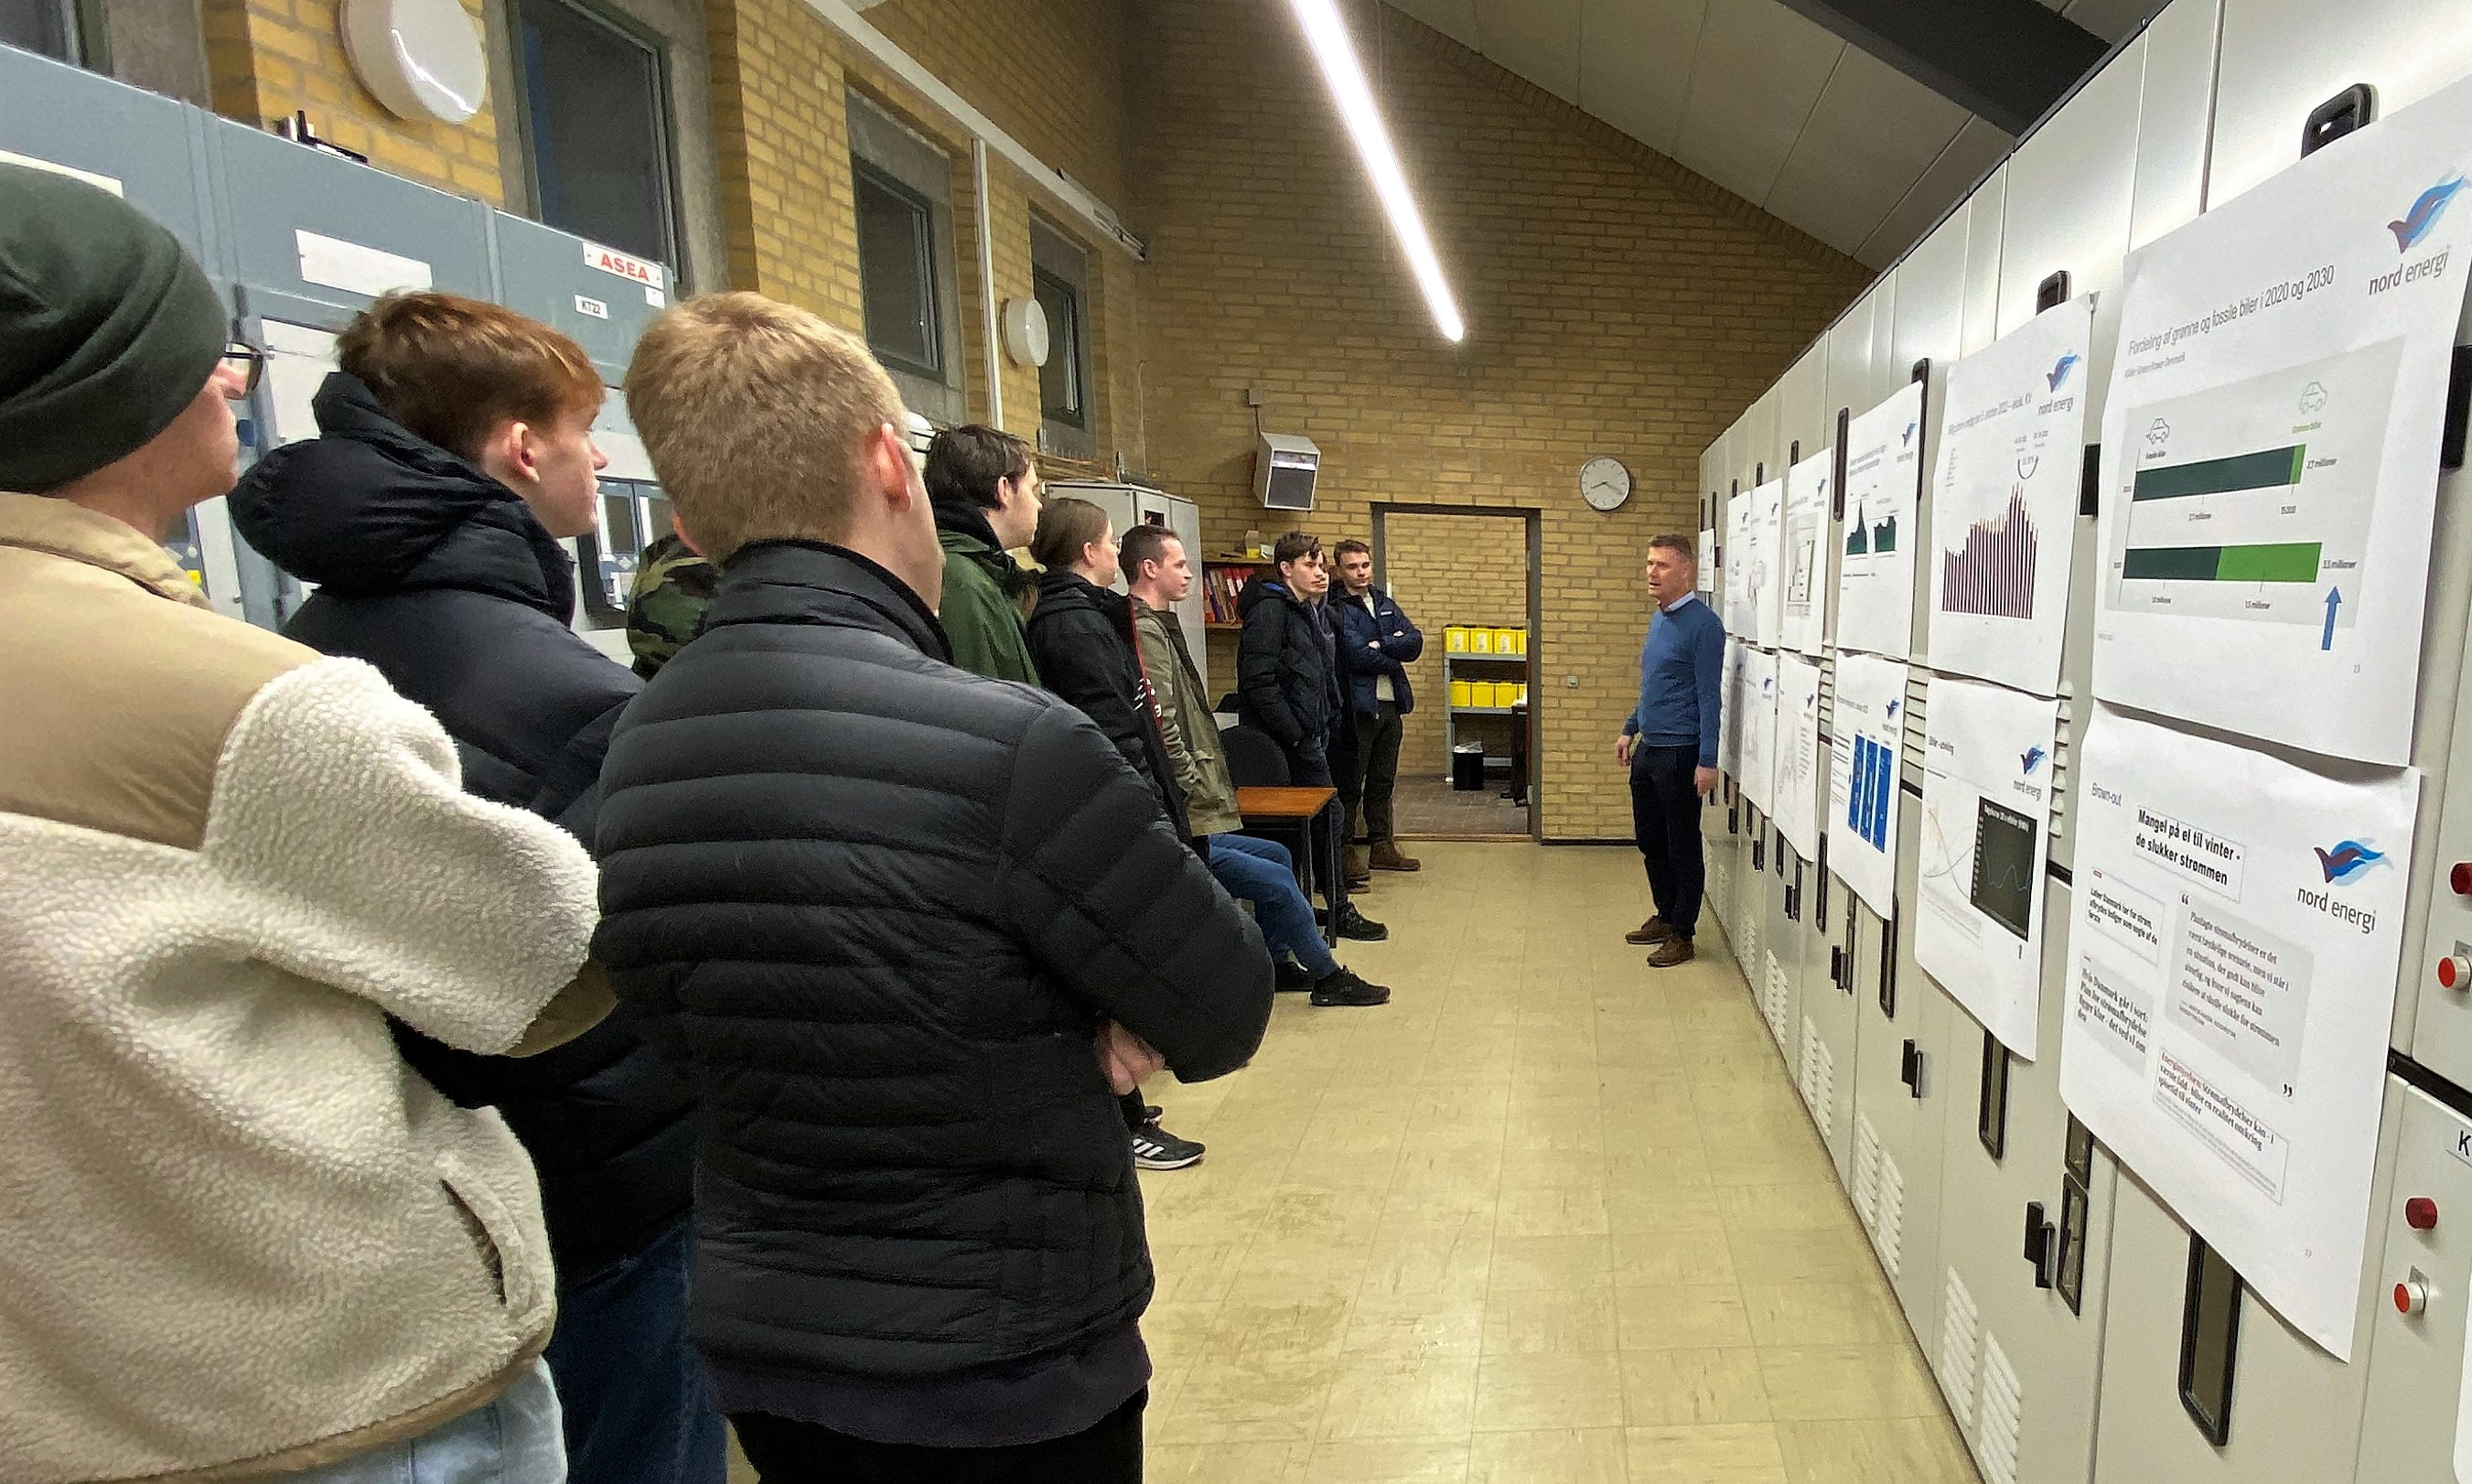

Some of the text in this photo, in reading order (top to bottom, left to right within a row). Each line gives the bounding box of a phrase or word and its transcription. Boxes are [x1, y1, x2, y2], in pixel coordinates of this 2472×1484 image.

[600, 253, 650, 282] ASEA
[2369, 244, 2451, 296] nord energi
[581, 300, 601, 315] KT22
[2162, 327, 2172, 345] af
[2200, 316, 2211, 335] og
[2264, 282, 2289, 307] 2020
[2291, 280, 2305, 300] og
[2305, 264, 2335, 293] 2030
[2090, 782, 2123, 807] Brown-out
[2135, 833, 2228, 886] de slukker strømmen
[2138, 809, 2167, 833] Mangel
[2168, 820, 2179, 839] på
[2182, 828, 2191, 842] el
[2193, 832, 2203, 848] til
[2205, 837, 2234, 861] vinter
[2297, 887, 2377, 934] nord energi
